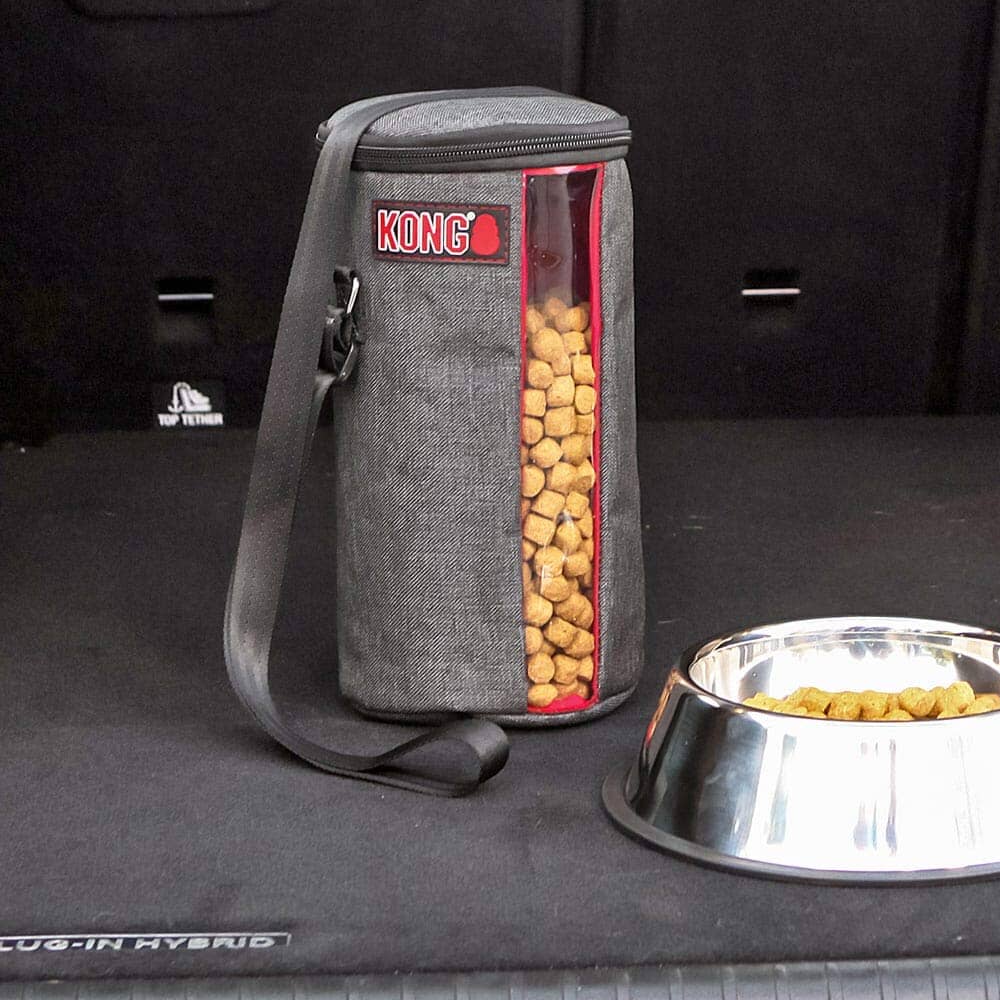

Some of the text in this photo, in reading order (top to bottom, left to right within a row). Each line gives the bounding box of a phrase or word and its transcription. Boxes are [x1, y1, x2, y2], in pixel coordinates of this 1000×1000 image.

[377, 209, 470, 256] KONG
[158, 413, 180, 426] TOP
[134, 937, 275, 950] HYBRID
